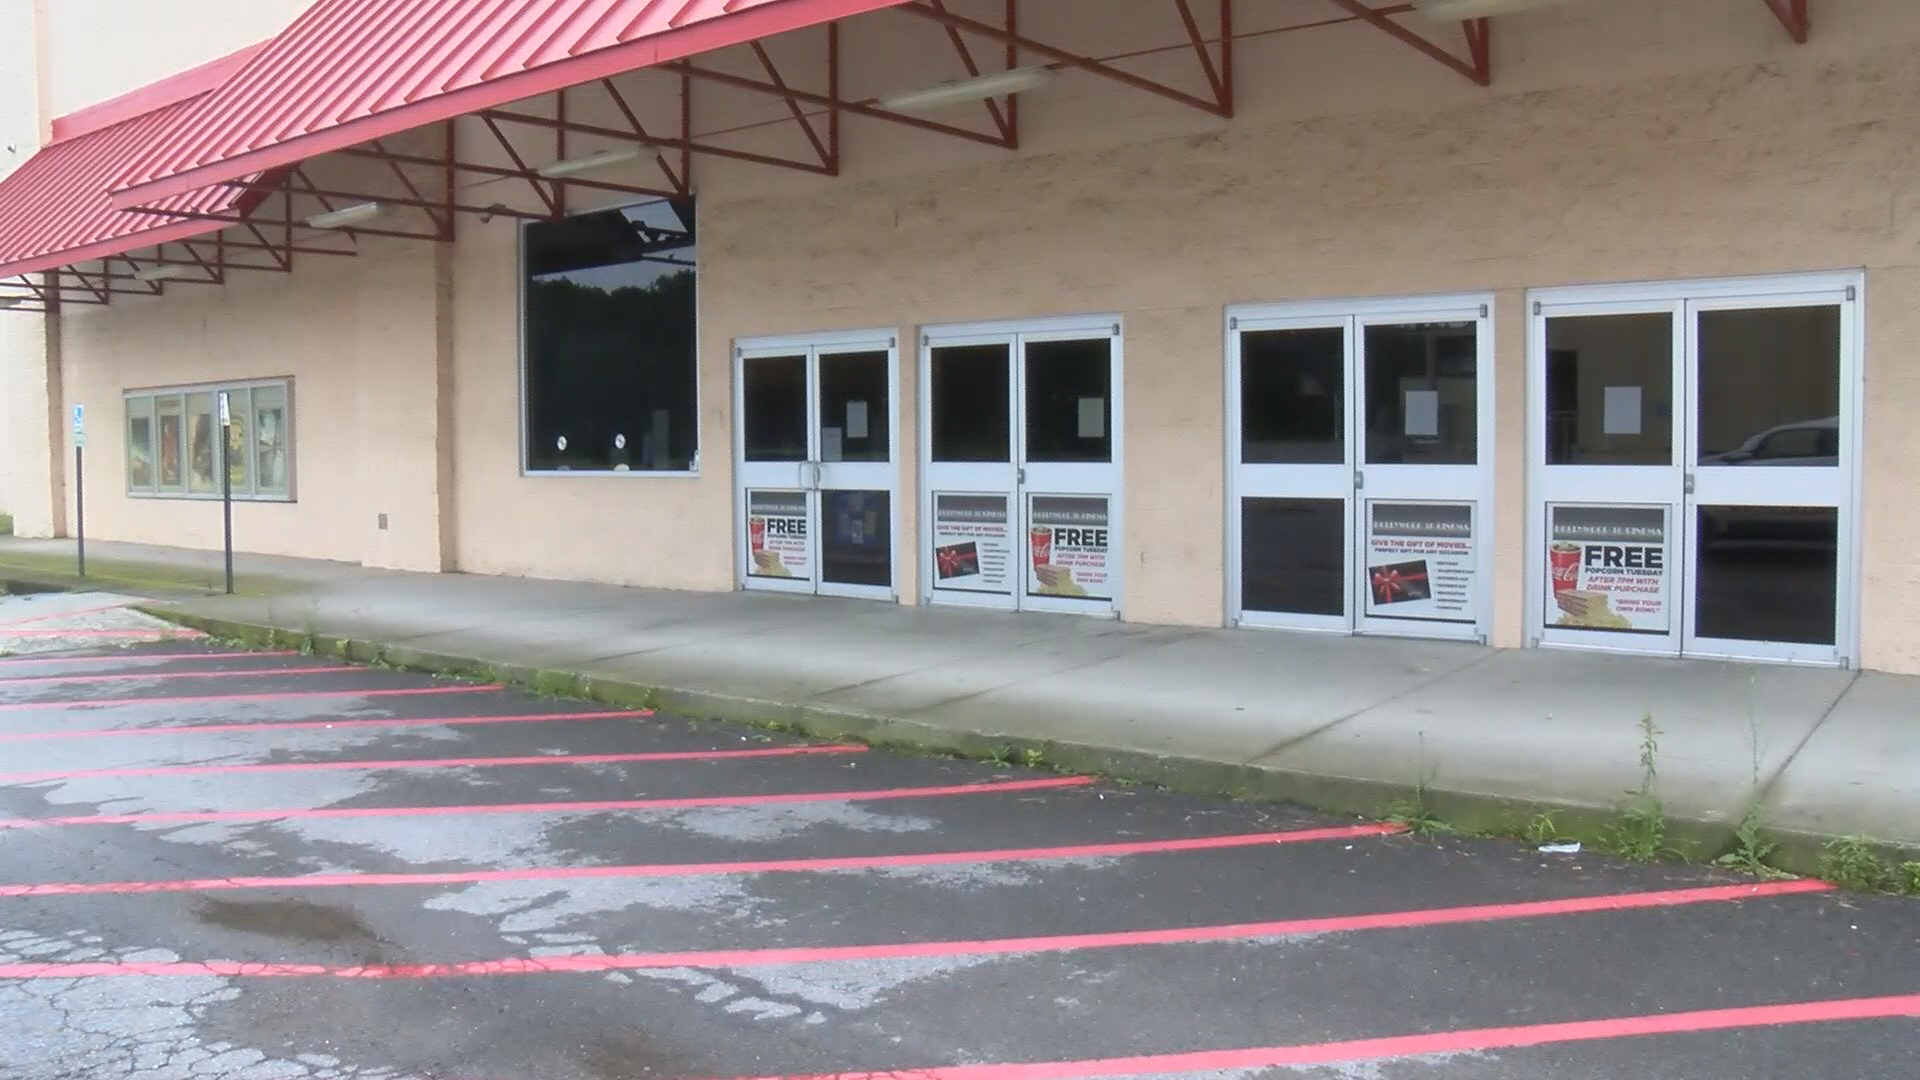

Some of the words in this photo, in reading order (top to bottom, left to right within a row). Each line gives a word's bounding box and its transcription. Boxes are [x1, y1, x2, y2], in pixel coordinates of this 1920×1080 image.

[767, 518, 807, 534] FREE
[1054, 528, 1108, 547] FREE
[1584, 545, 1664, 569] FREE
[1584, 567, 1624, 575] POPCORN
[1626, 568, 1664, 576] TUESDAY
[1587, 576, 1615, 584] AFTER
[1616, 577, 1634, 585] 7PM
[1635, 578, 1659, 586] WITH
[1614, 585, 1660, 593] PURCHASE
